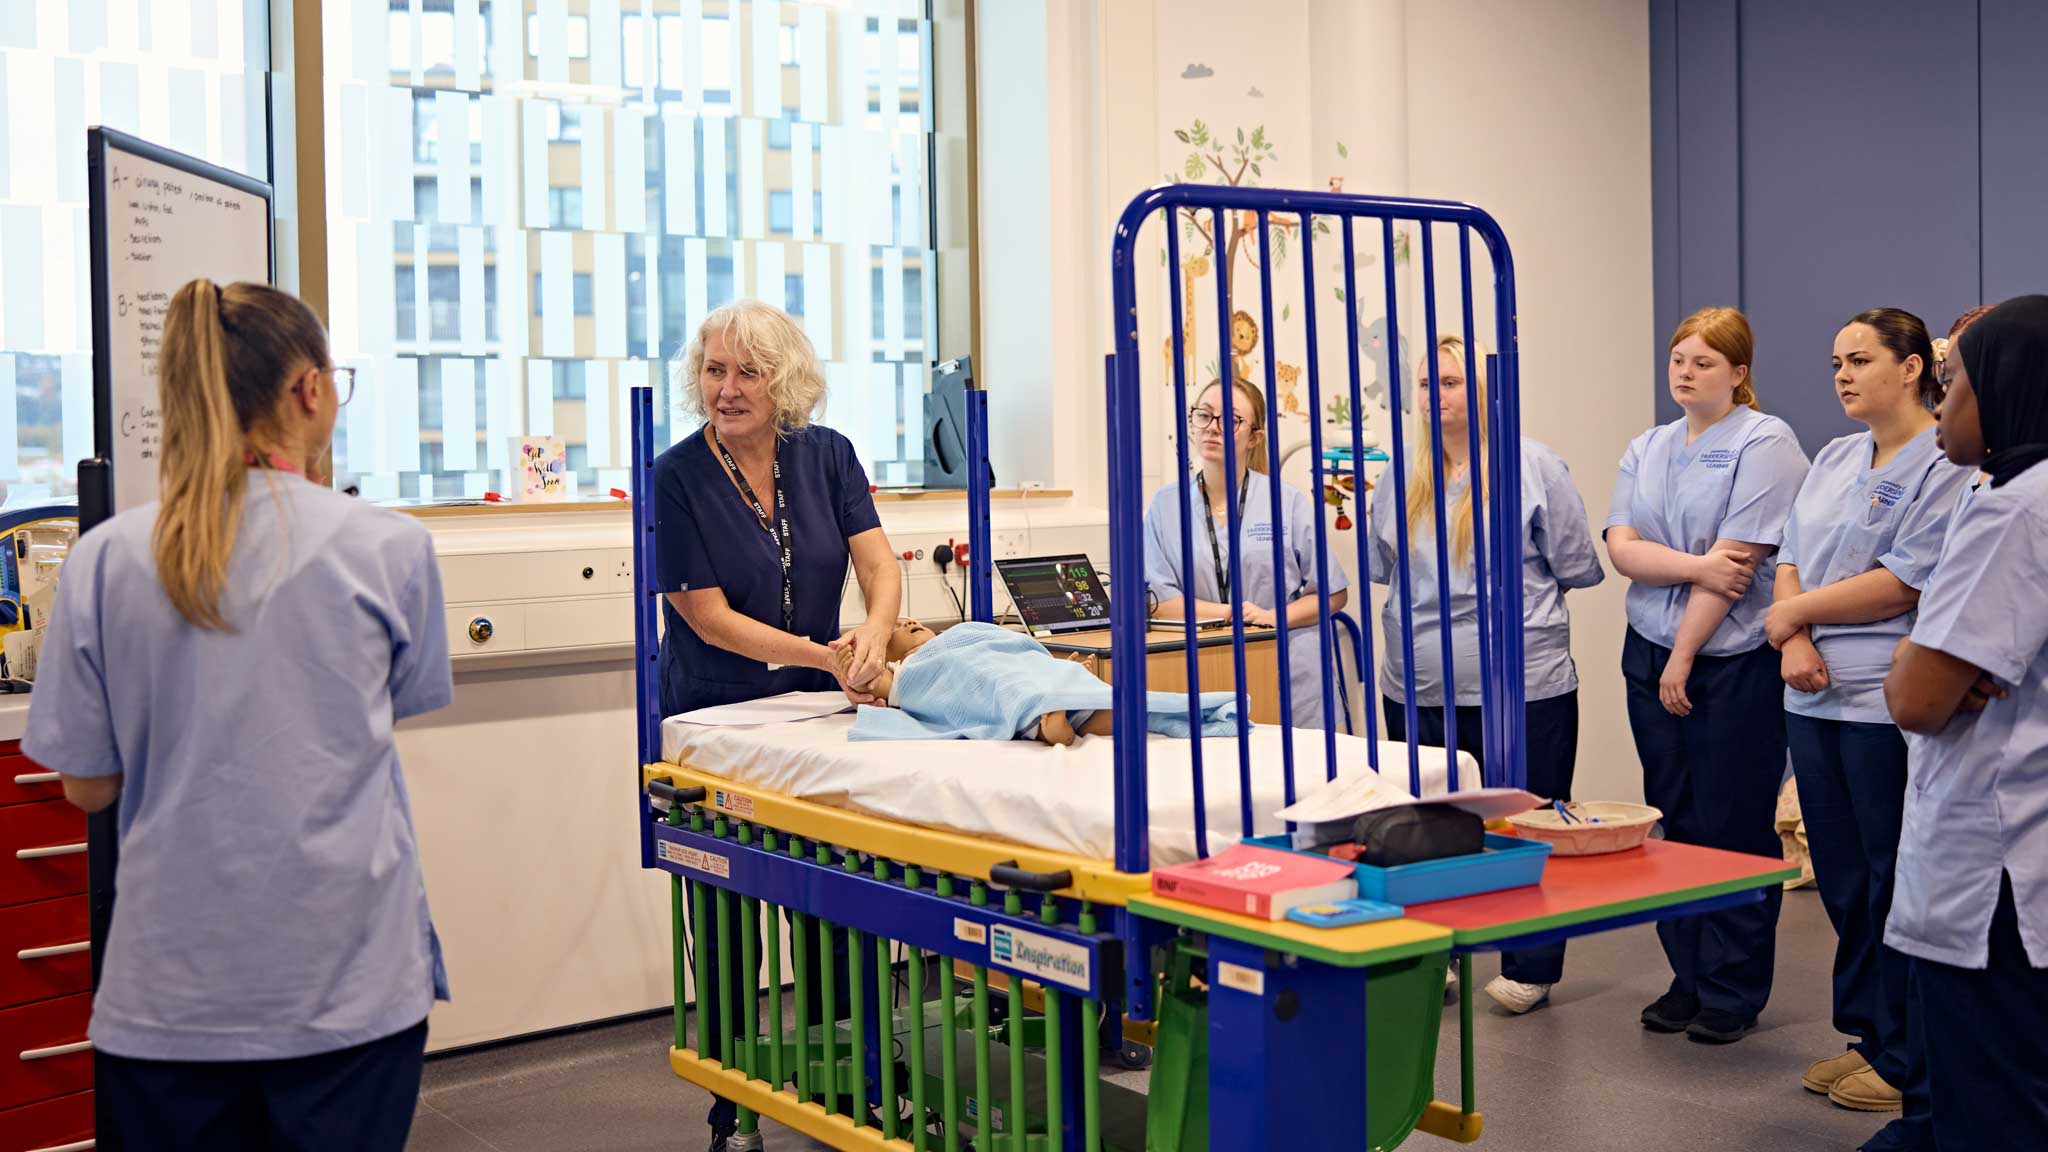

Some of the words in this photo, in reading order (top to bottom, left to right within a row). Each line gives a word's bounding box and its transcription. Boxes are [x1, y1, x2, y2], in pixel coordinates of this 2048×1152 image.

[527, 447, 542, 461] Get
[533, 462, 553, 475] Well
[723, 453, 737, 472] STAFF
[540, 476, 560, 490] Soon
[777, 489, 785, 508] STAFF
[1870, 494, 1896, 507] LARNER
[753, 502, 767, 519] STAFF
[781, 518, 789, 537] STAFF
[769, 527, 781, 546] STAFF
[784, 547, 792, 567] STAFF
[1068, 567, 1088, 578] 115
[1074, 580, 1089, 591] 98
[1080, 593, 1094, 601] 32
[733, 794, 753, 804] CAUTION
[1015, 937, 1086, 979] Inspiration
